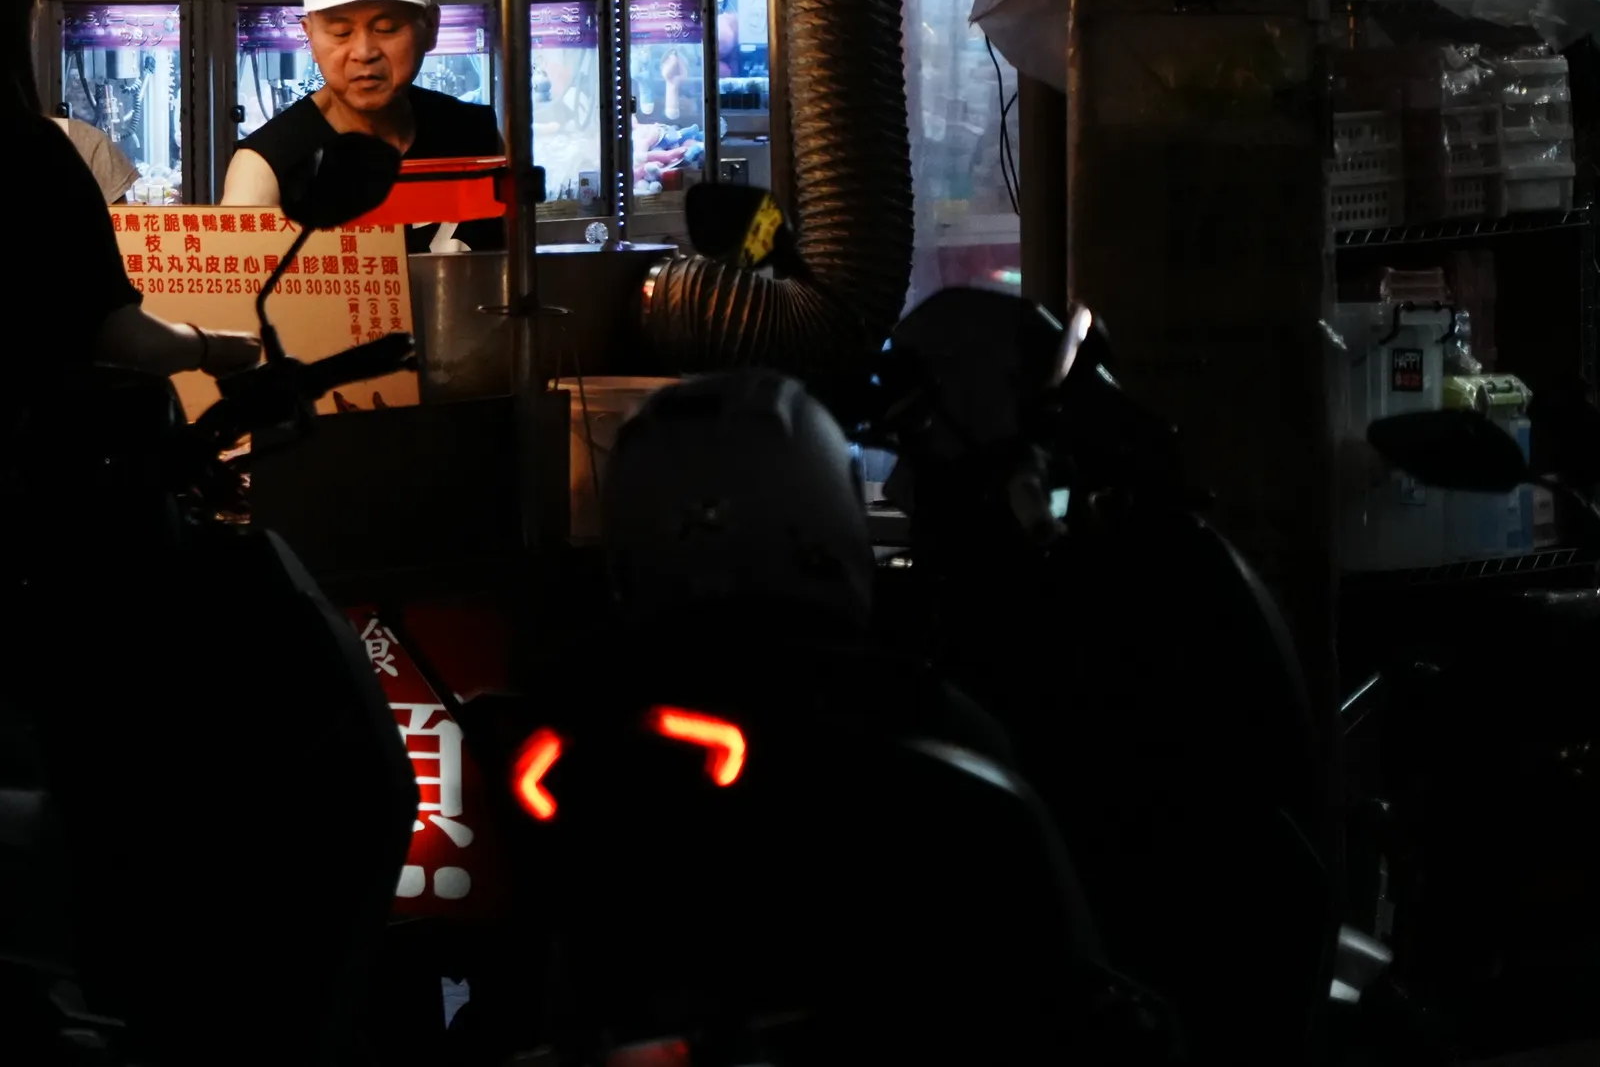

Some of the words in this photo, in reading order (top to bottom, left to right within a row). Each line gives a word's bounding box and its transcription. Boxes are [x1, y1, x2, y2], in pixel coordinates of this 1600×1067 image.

[148, 278, 164, 294] 30
[168, 278, 184, 294] 25
[188, 278, 204, 294] 25
[206, 278, 223, 294] 25
[226, 278, 242, 294] 25
[245, 278, 261, 295] 30
[285, 279, 301, 295] 30
[306, 279, 322, 295] 30
[324, 279, 341, 295] 30
[344, 280, 361, 295] 35
[364, 280, 381, 296] 40
[384, 280, 401, 296] 50
